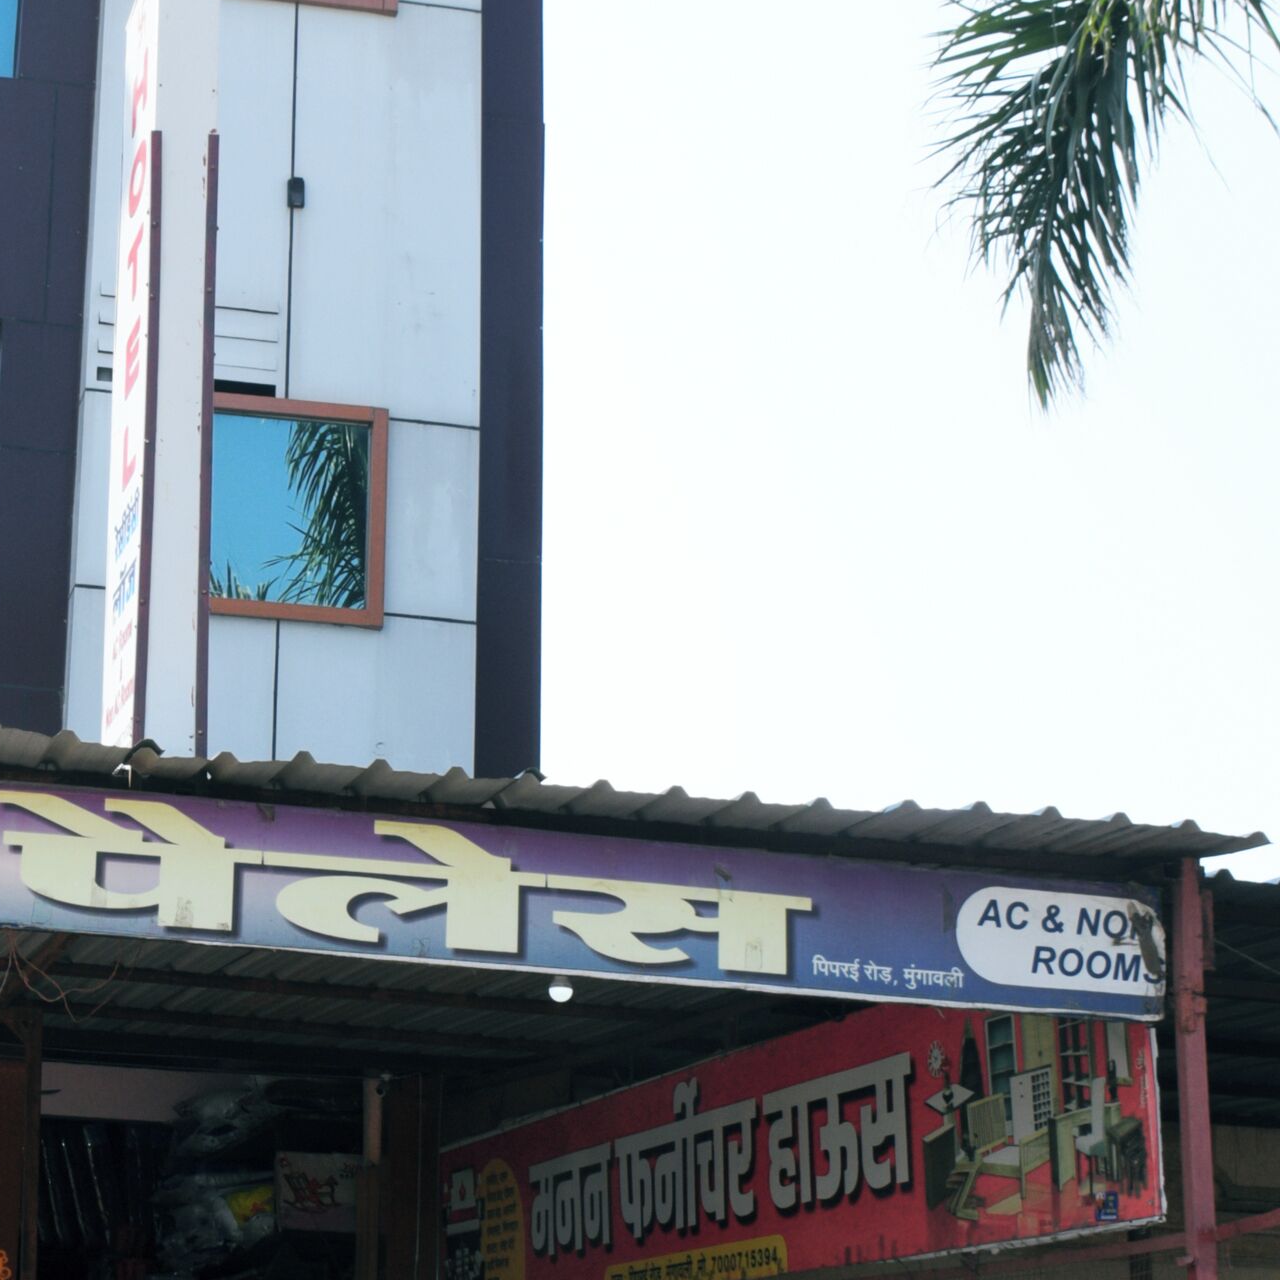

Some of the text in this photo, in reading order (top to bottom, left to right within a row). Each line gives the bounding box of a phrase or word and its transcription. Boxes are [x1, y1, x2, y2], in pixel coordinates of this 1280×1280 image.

[122, 48, 149, 492] HOTEL
[977, 898, 1030, 930] AC
[1041, 904, 1064, 934] &
[528, 1142, 611, 1256] मनन
[615, 1077, 757, 1239] फर्नीचर
[762, 1052, 912, 1210] हाऊस
